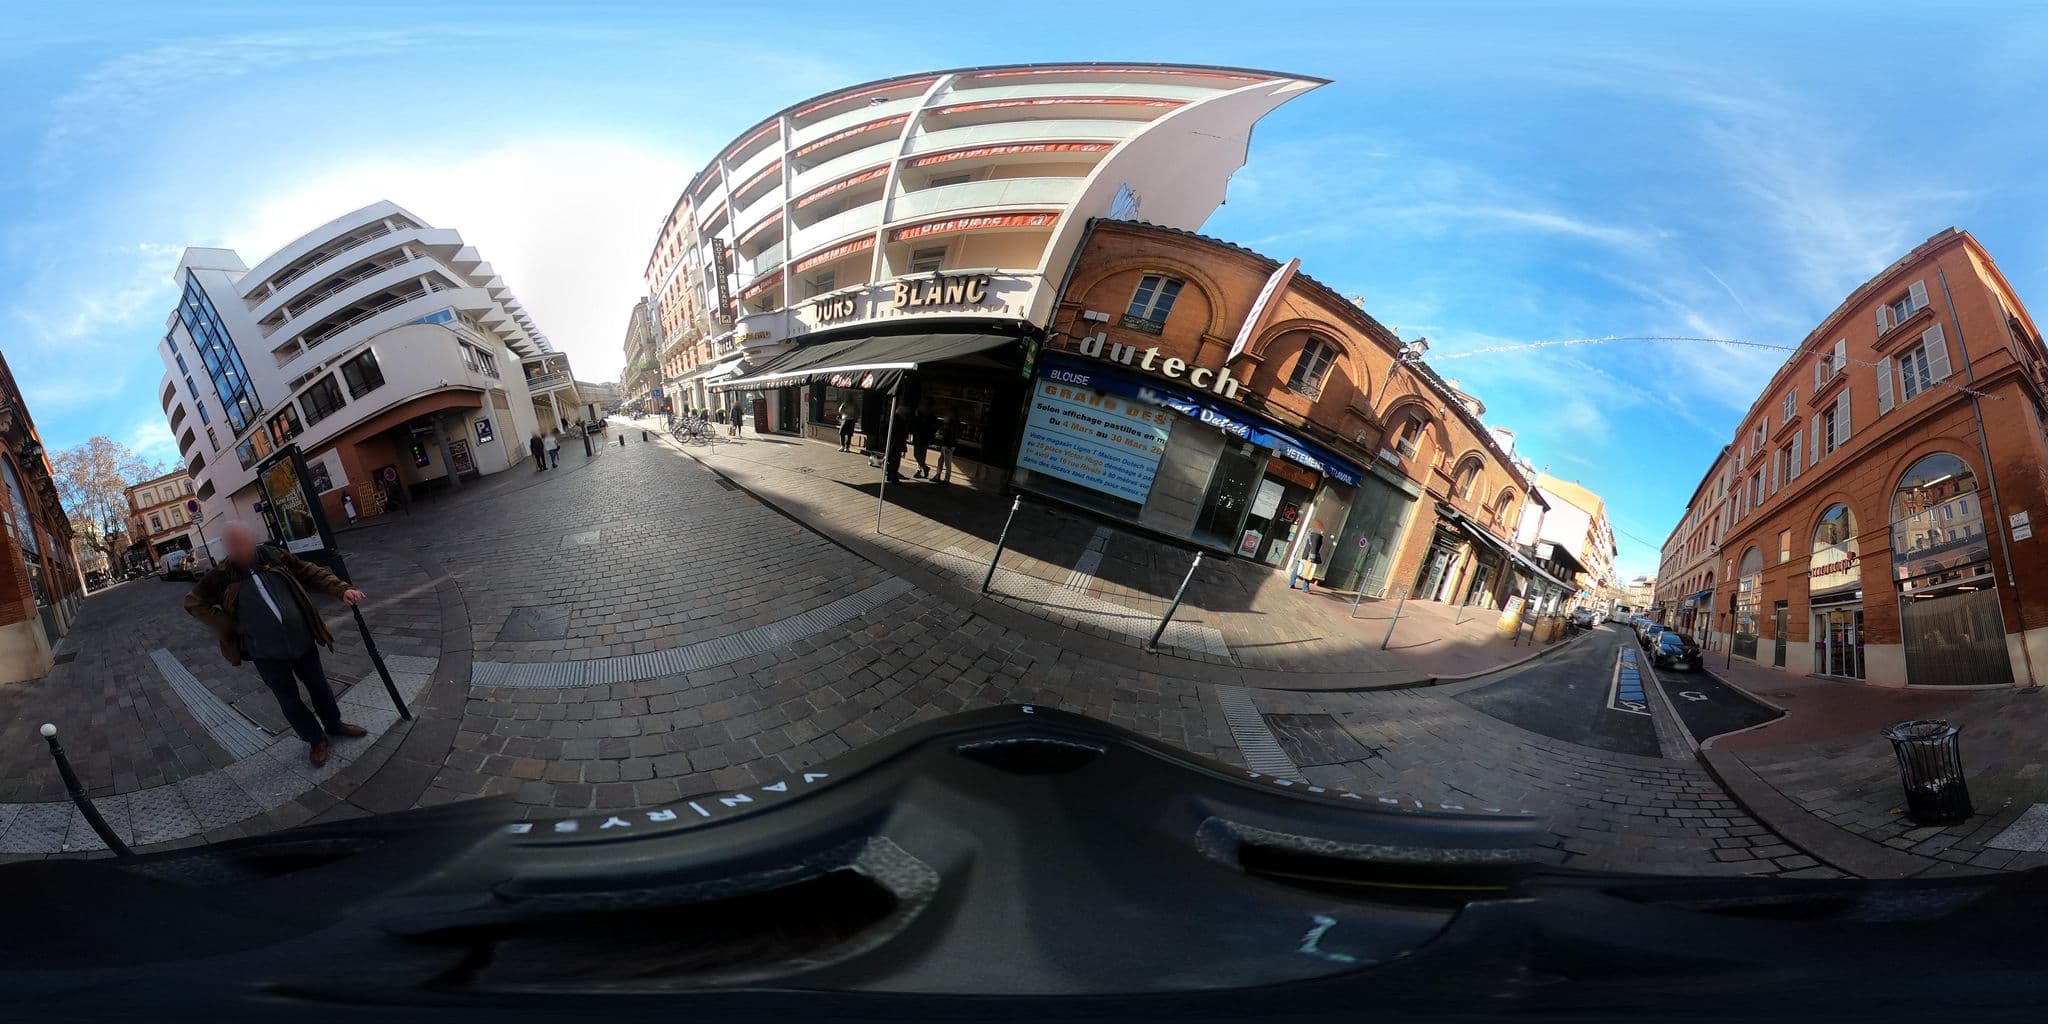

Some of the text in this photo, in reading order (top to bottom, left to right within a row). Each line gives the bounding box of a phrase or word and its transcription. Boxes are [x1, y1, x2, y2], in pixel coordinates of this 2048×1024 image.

[894, 275, 989, 309] BLANC
[1050, 369, 1090, 385] BLOUSE
[1079, 332, 1239, 399] dutech
[1036, 402, 1060, 413] Selon
[1061, 409, 1103, 425] affichage
[1103, 420, 1143, 436] pastilles
[1142, 432, 1155, 441] en
[1048, 416, 1061, 426] Du
[1061, 419, 1069, 427] 4
[1070, 423, 1094, 433] Mars
[1095, 430, 1108, 438] au
[1110, 433, 1122, 442] 30
[1124, 438, 1148, 449] Mars
[1126, 405, 1175, 427] DES
